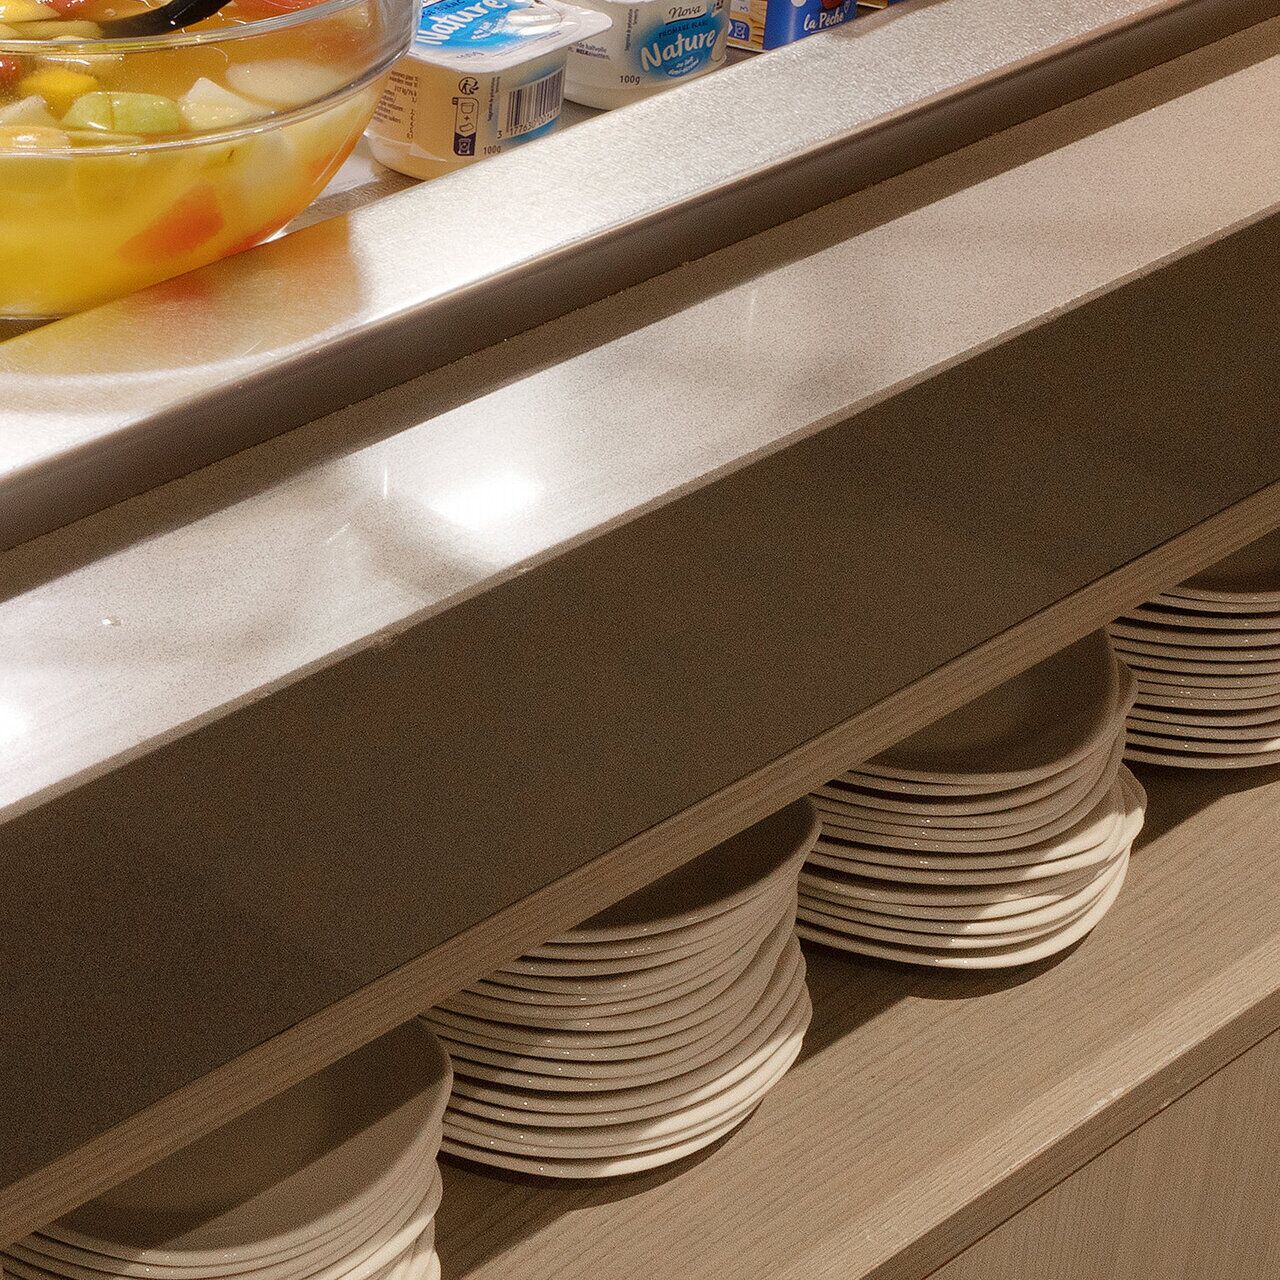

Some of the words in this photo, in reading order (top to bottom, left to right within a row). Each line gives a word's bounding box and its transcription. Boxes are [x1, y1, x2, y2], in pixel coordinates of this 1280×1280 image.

[668, 5, 702, 19] Nova
[803, 14, 816, 31] la
[640, 29, 716, 71] Nature
[619, 74, 641, 86] 100g
